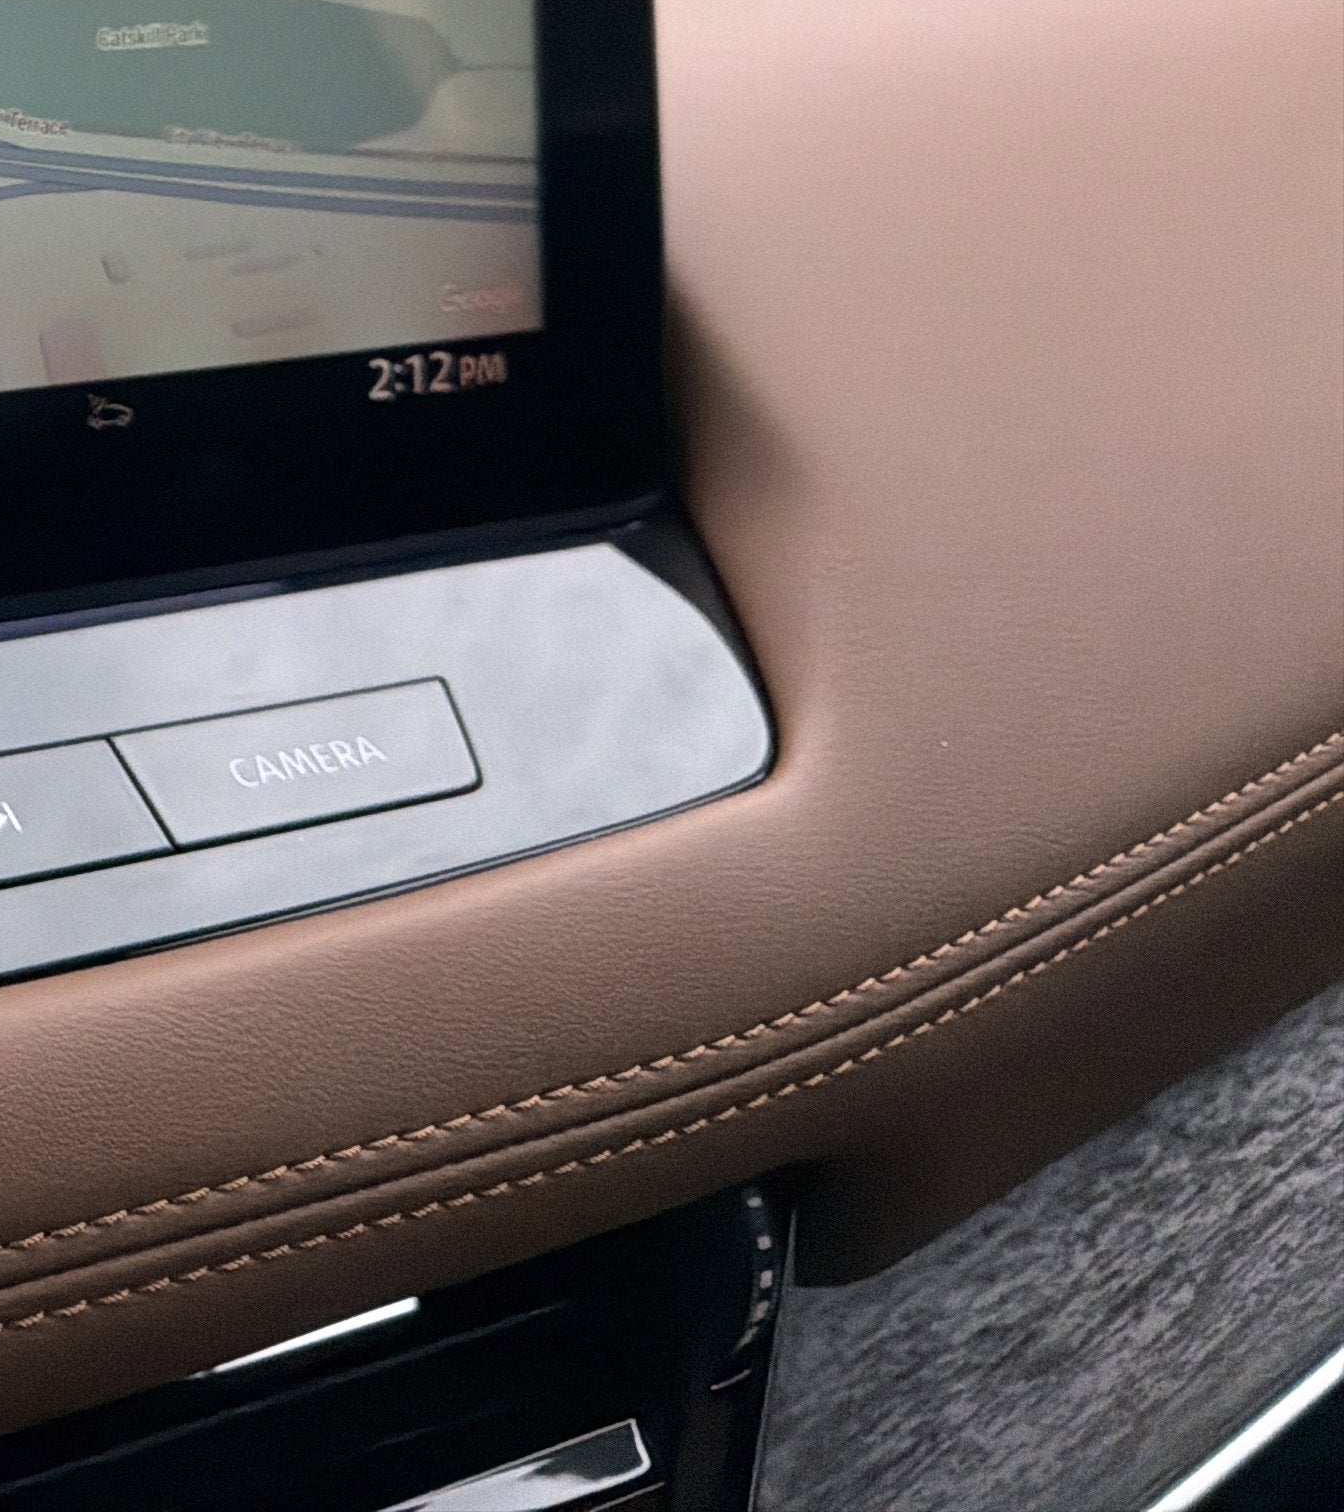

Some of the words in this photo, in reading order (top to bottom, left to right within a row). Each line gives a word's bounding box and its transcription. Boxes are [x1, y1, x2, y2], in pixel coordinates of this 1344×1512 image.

[8, 110, 69, 135] Terrace
[367, 350, 455, 402] 2:12
[458, 352, 508, 388] PM
[228, 735, 389, 789] CAMERA
